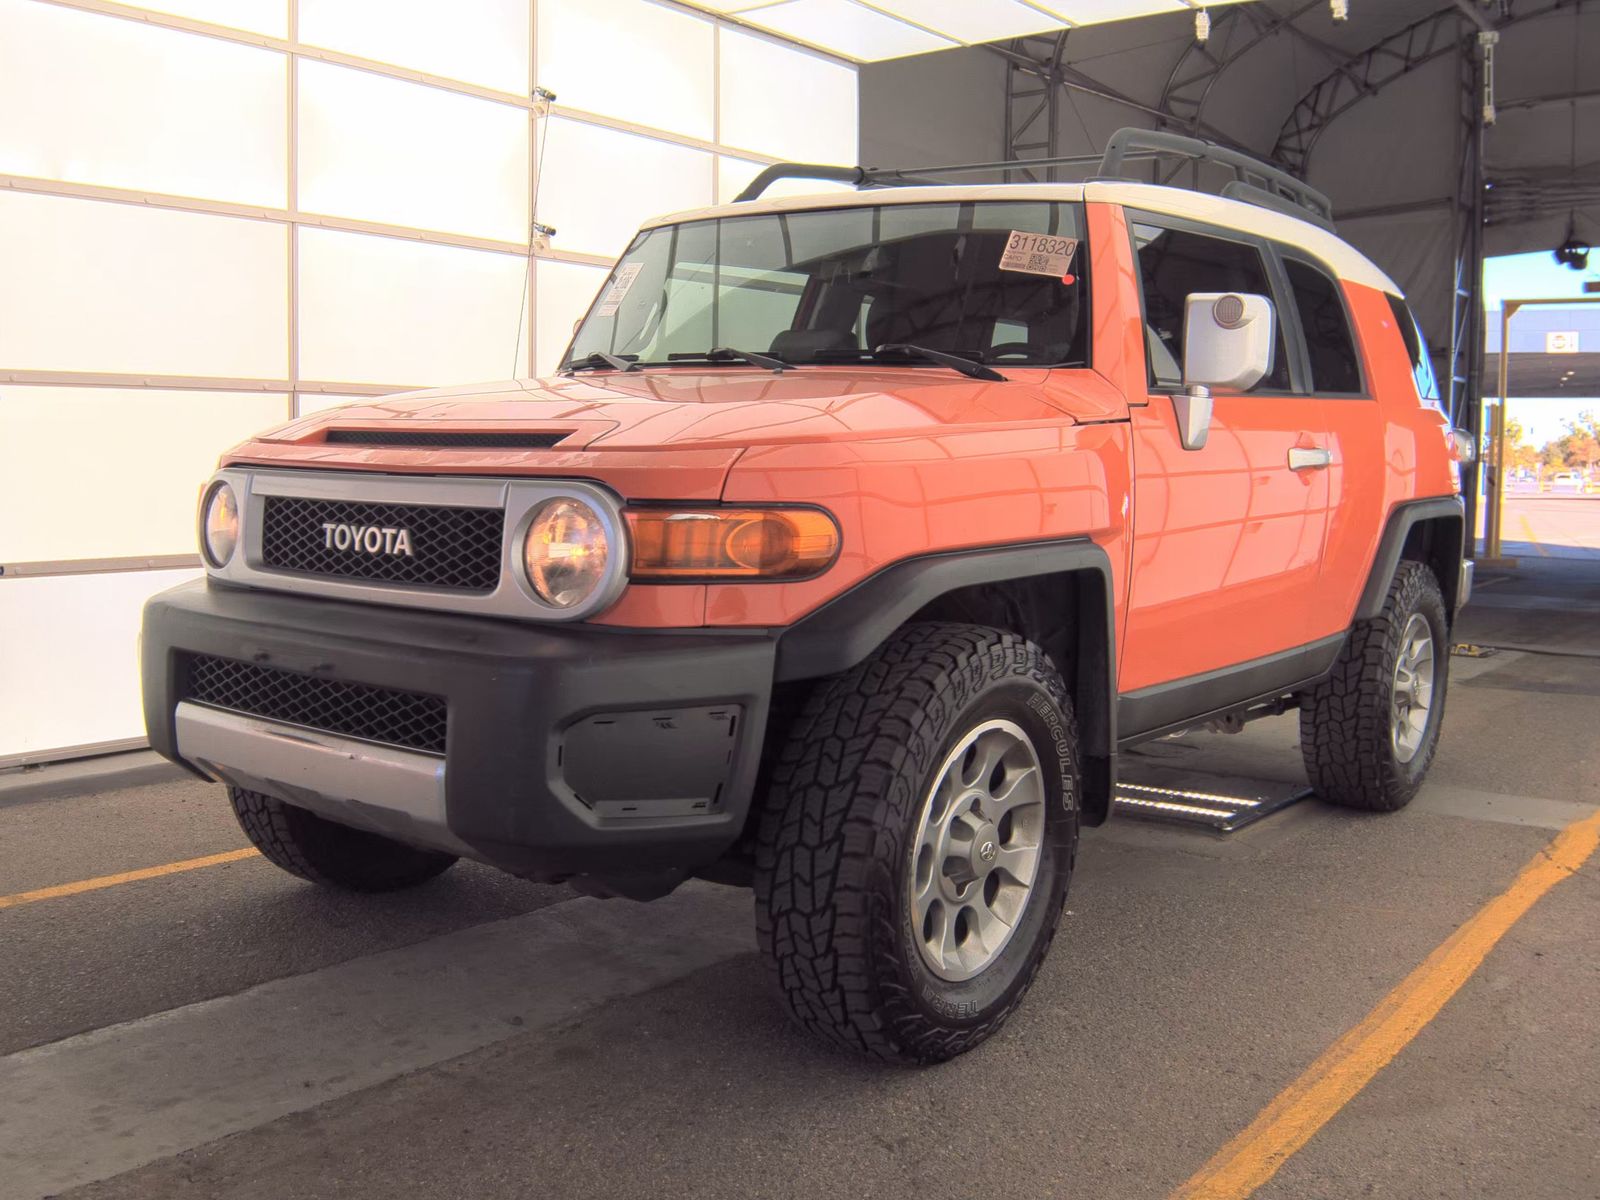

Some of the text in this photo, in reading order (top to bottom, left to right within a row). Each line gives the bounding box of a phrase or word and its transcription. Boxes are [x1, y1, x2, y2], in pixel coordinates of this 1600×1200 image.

[1010, 234, 1075, 257] 3118320
[322, 523, 413, 556] TOYOTA
[1026, 692, 1074, 811] HERCULES
